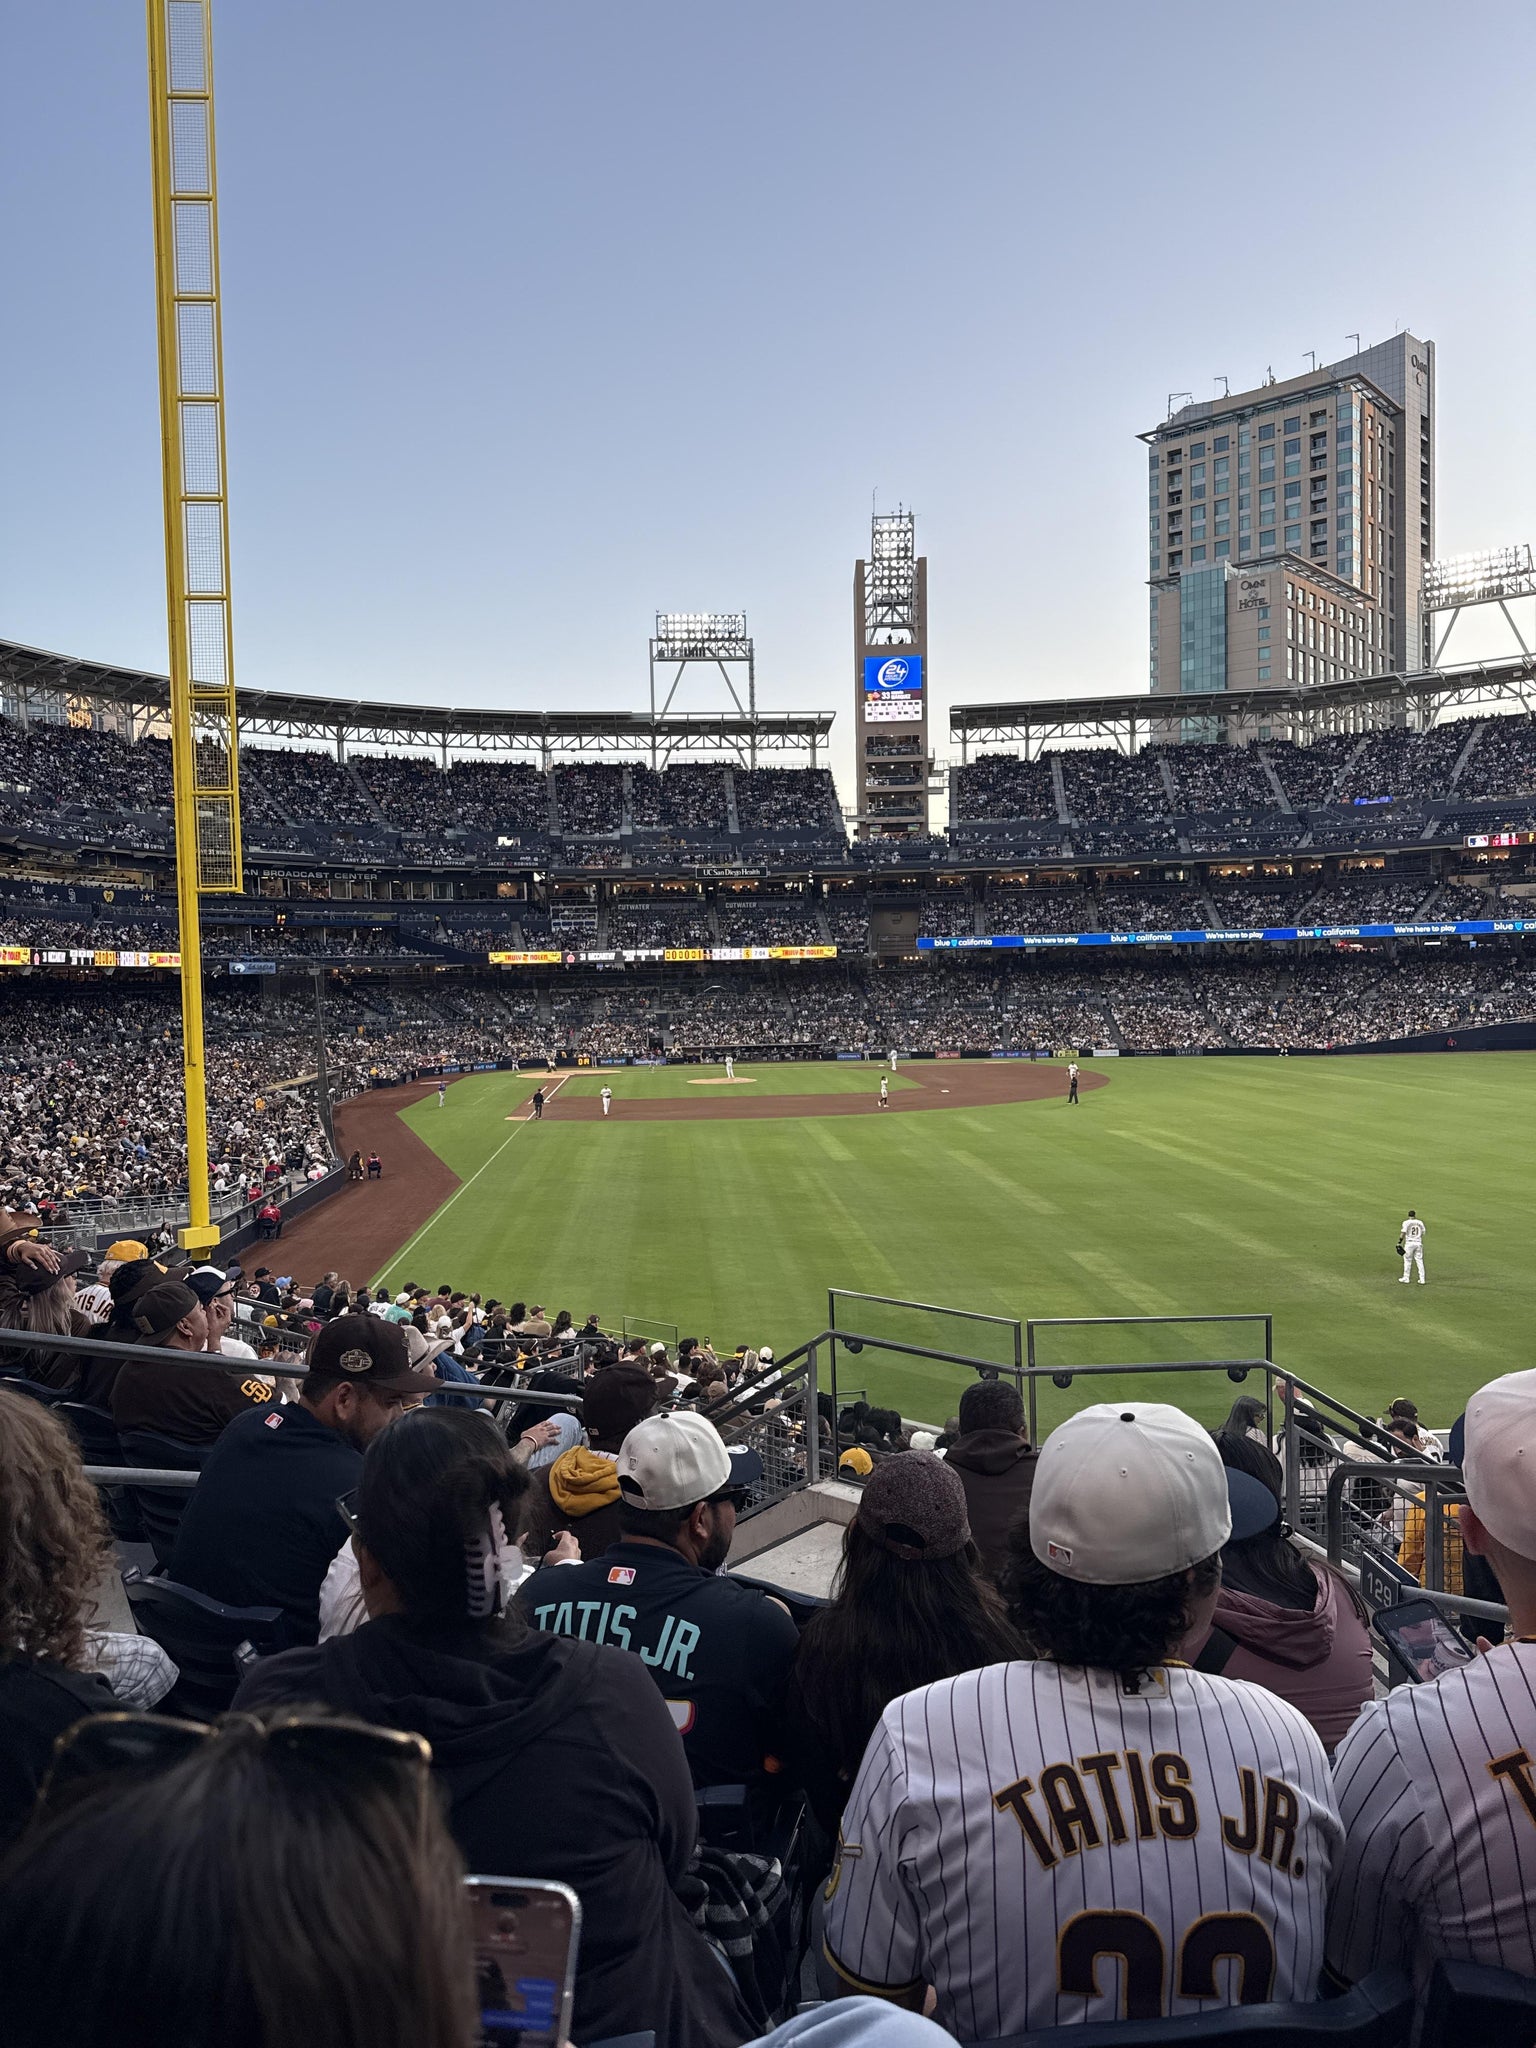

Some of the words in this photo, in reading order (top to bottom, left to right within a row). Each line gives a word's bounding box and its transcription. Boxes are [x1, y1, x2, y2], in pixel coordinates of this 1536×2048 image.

[1238, 597, 1268, 609] HOTEL
[885, 664, 907, 678] 24
[263, 870, 330, 879] BROADCAST
[725, 869, 742, 877] Diego
[32, 886, 45, 894] RAK
[1494, 922, 1514, 930] blue
[1248, 932, 1264, 940] play
[1322, 928, 1360, 936] california
[934, 938, 950, 946] blue
[1111, 934, 1128, 942] blue
[1367, 1571, 1393, 1608] 129
[534, 1601, 638, 1651] TATIS
[639, 1614, 701, 1681] JR.
[992, 1749, 1199, 1869] TATIS
[1221, 1765, 1305, 1880] JR.
